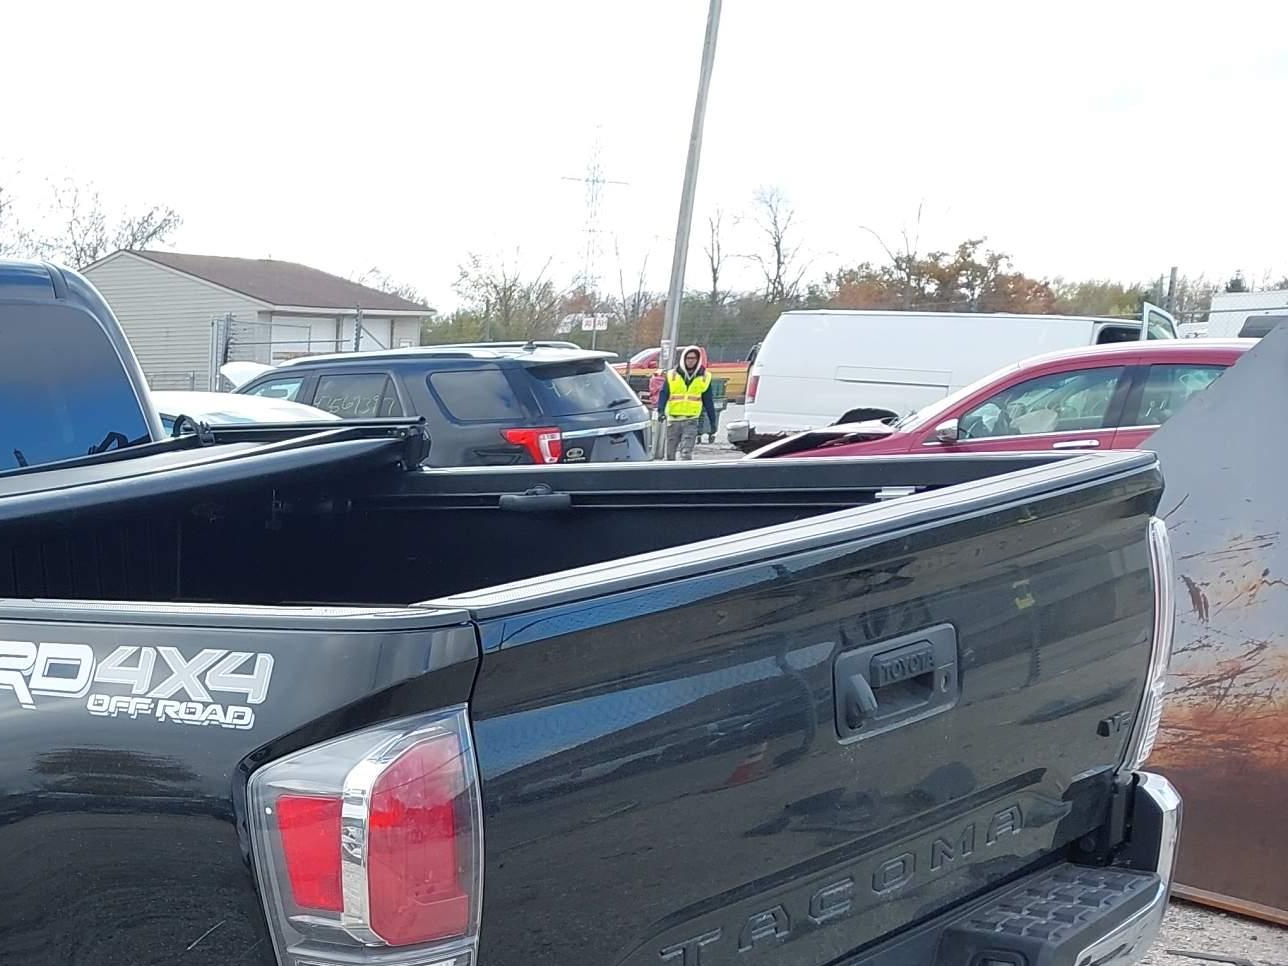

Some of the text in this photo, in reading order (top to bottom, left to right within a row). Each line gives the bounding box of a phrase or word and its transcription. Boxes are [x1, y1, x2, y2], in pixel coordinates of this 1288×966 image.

[880, 651, 935, 683] TOYOTA
[86, 693, 257, 730] OFF ROAD
